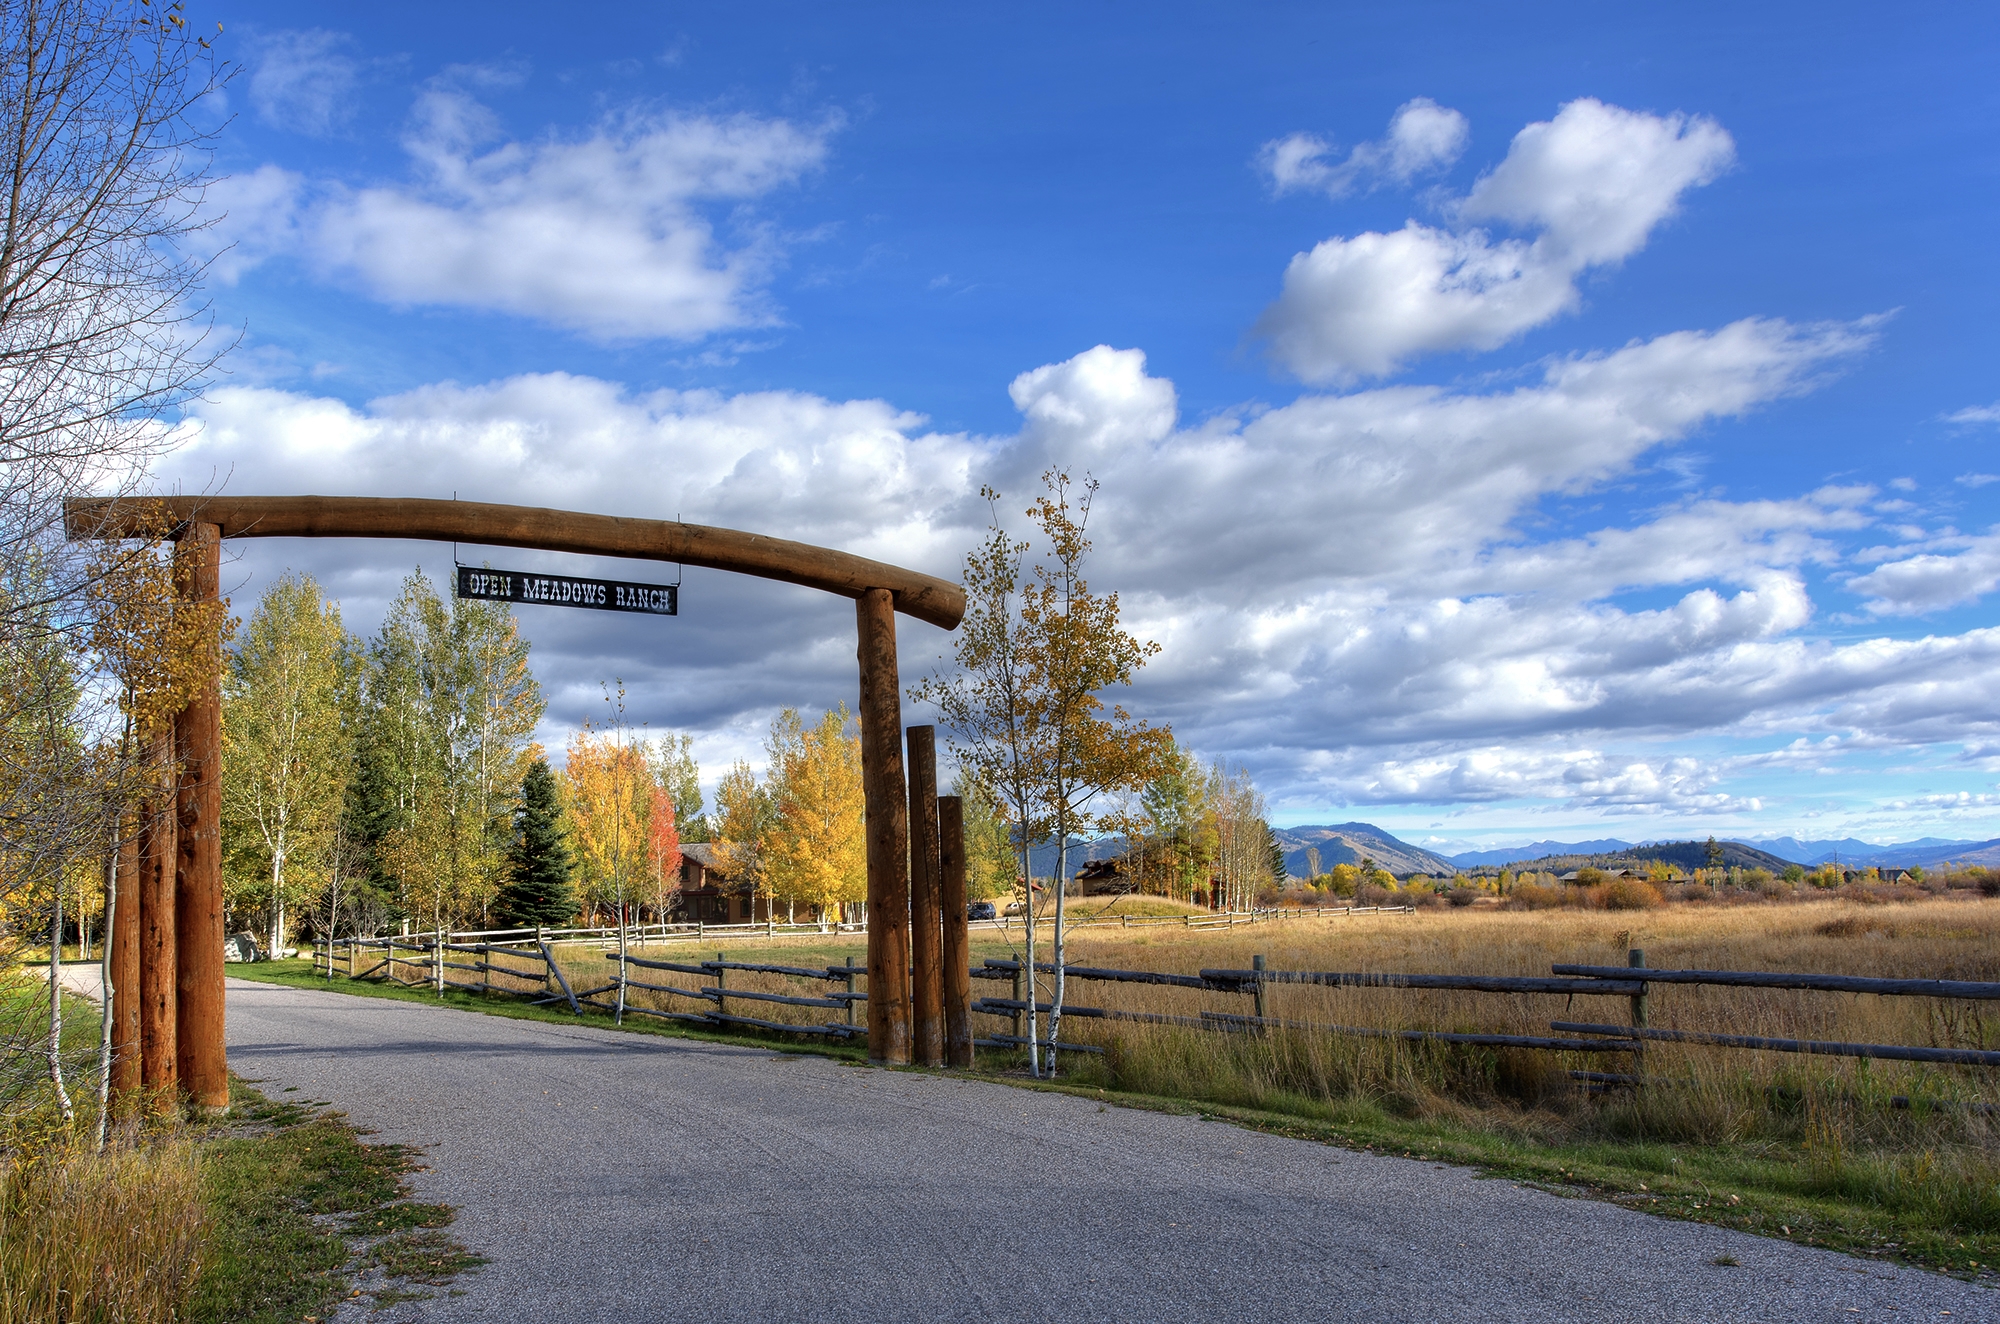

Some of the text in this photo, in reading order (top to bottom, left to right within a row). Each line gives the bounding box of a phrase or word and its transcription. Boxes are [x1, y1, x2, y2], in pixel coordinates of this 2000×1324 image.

[470, 573, 670, 609] OPEN MEADOWS RANCH
